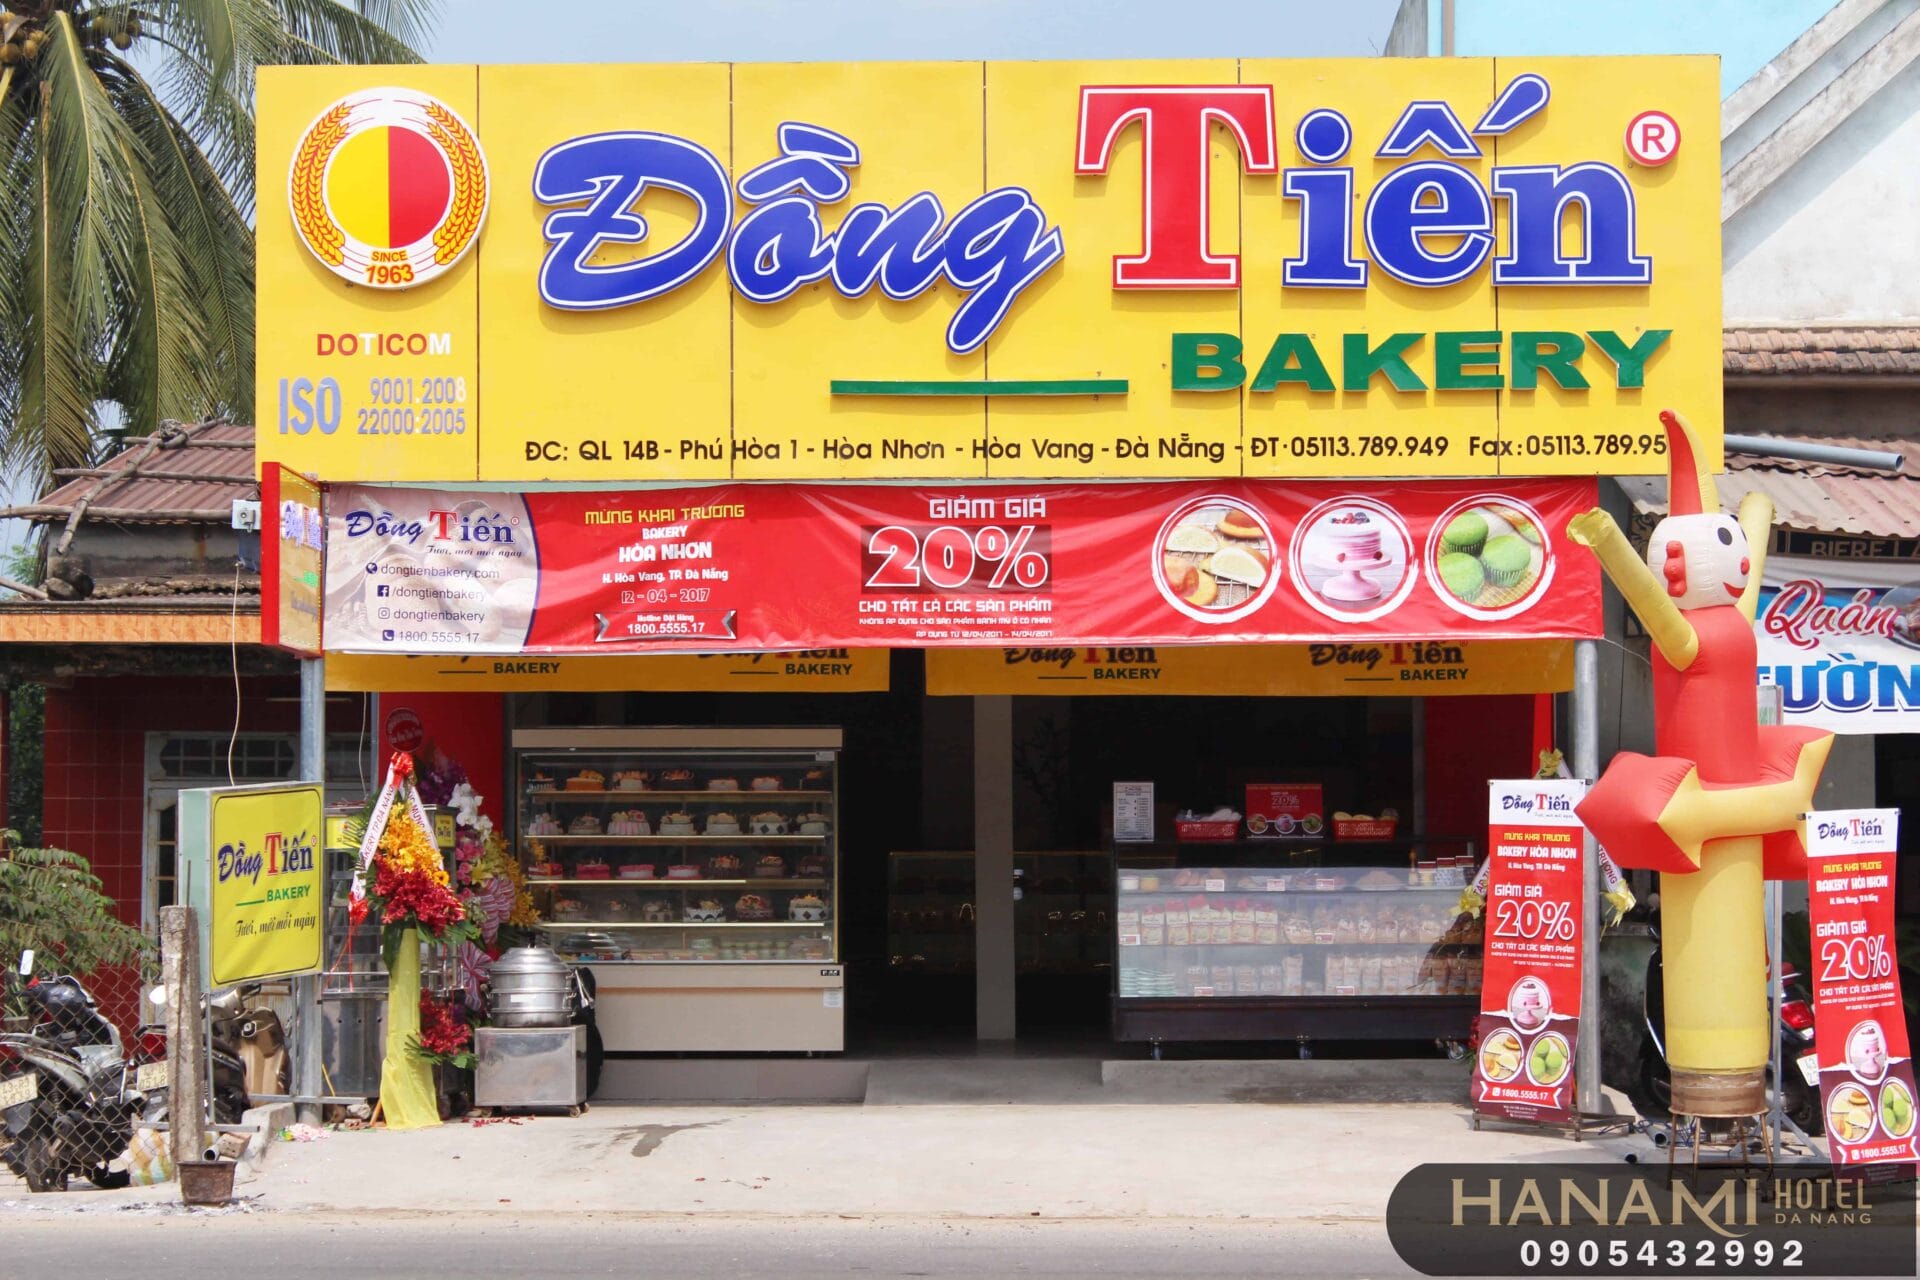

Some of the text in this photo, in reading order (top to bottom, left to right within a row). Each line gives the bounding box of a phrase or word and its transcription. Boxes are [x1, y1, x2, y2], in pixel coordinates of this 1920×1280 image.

[533, 121, 1066, 355] Đồng
[1074, 74, 1653, 290] Tiến
[371, 250, 408, 263] SINCE
[365, 264, 415, 284] 1963
[316, 333, 452, 356] DOTICOM
[1171, 330, 1673, 393] BAKERY
[279, 377, 342, 434] ISO
[358, 408, 466, 435] 22000:2005
[525, 441, 568, 461] ĐC:
[579, 440, 612, 461] QL
[680, 438, 723, 460] Phú
[732, 437, 780, 459] Hòa
[790, 440, 797, 459] 1
[823, 436, 872, 460] Hòa
[882, 438, 944, 459] Nhơn
[972, 435, 1021, 459] Hòa
[1032, 438, 1093, 463] Vang
[1116, 435, 1149, 458] Đà
[1158, 433, 1224, 463] Nẵng
[929, 495, 1046, 518] GIẢM GIÁ
[639, 509, 675, 522] KHAI
[345, 511, 424, 544] Đồng
[429, 510, 514, 543] Tiến
[642, 525, 688, 540] BAKERY
[619, 543, 656, 562] HÒA
[865, 525, 1048, 588] 20%
[381, 564, 500, 580] dongtienbakery.com
[647, 589, 667, 603] 04
[680, 588, 710, 602] 2017
[859, 600, 886, 612] CHO
[393, 609, 485, 624] dongtienbakery
[627, 622, 705, 634] 1800.5555.17
[494, 662, 560, 674] BAKERY
[786, 663, 852, 675] BAKERY
[1094, 668, 1161, 680] BAKERY
[1401, 669, 1468, 681] BAKERY
[218, 841, 263, 886] Đồng
[264, 829, 313, 876] Tiến
[1497, 846, 1528, 857] BAKERY
[1816, 878, 1849, 892] BAKERY
[266, 885, 310, 902] BAKERY
[1494, 899, 1575, 940] 20%
[1820, 934, 1891, 982] 20%
[1502, 1089, 1548, 1100] 1800.5555.17
